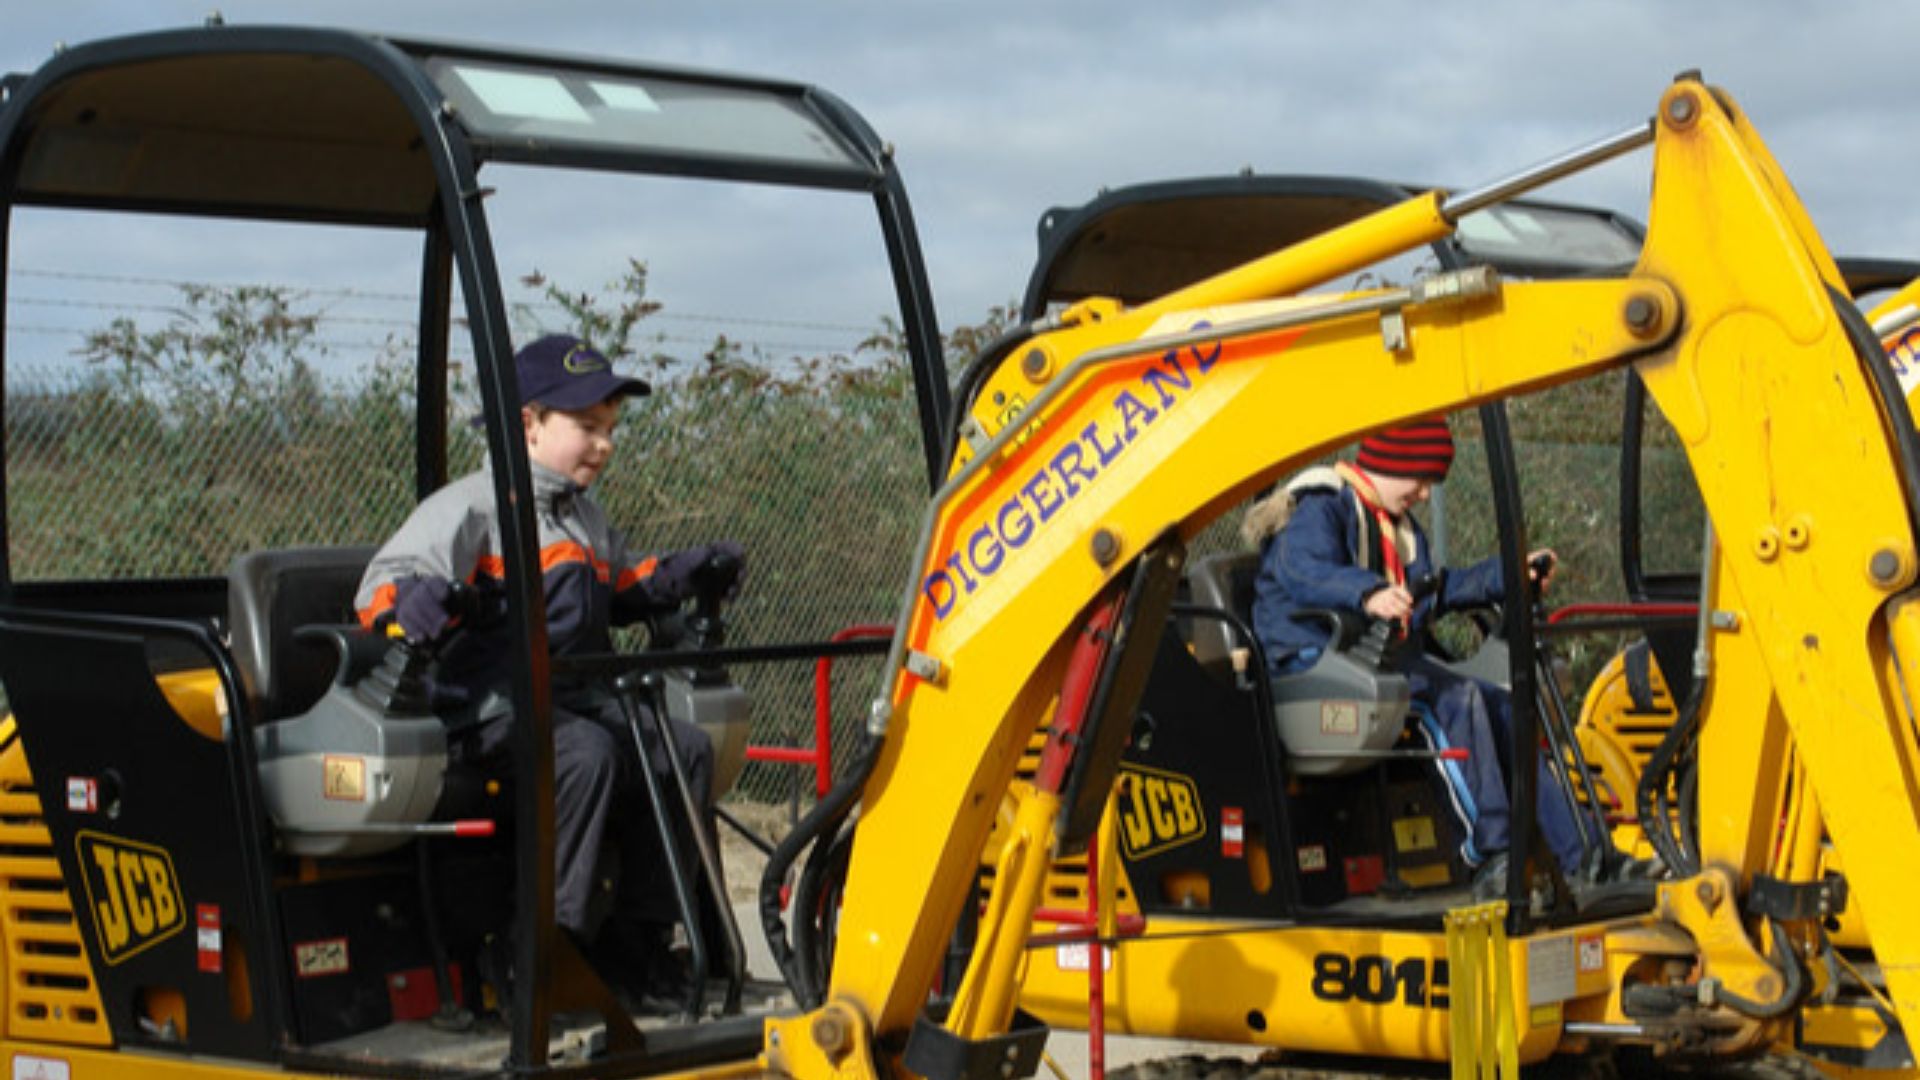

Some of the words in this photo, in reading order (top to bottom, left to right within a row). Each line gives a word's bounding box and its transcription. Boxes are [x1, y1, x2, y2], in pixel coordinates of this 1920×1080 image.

[921, 320, 1223, 620] DIGGERLAND
[1121, 771, 1198, 849] JCB
[92, 844, 178, 952] JCB
